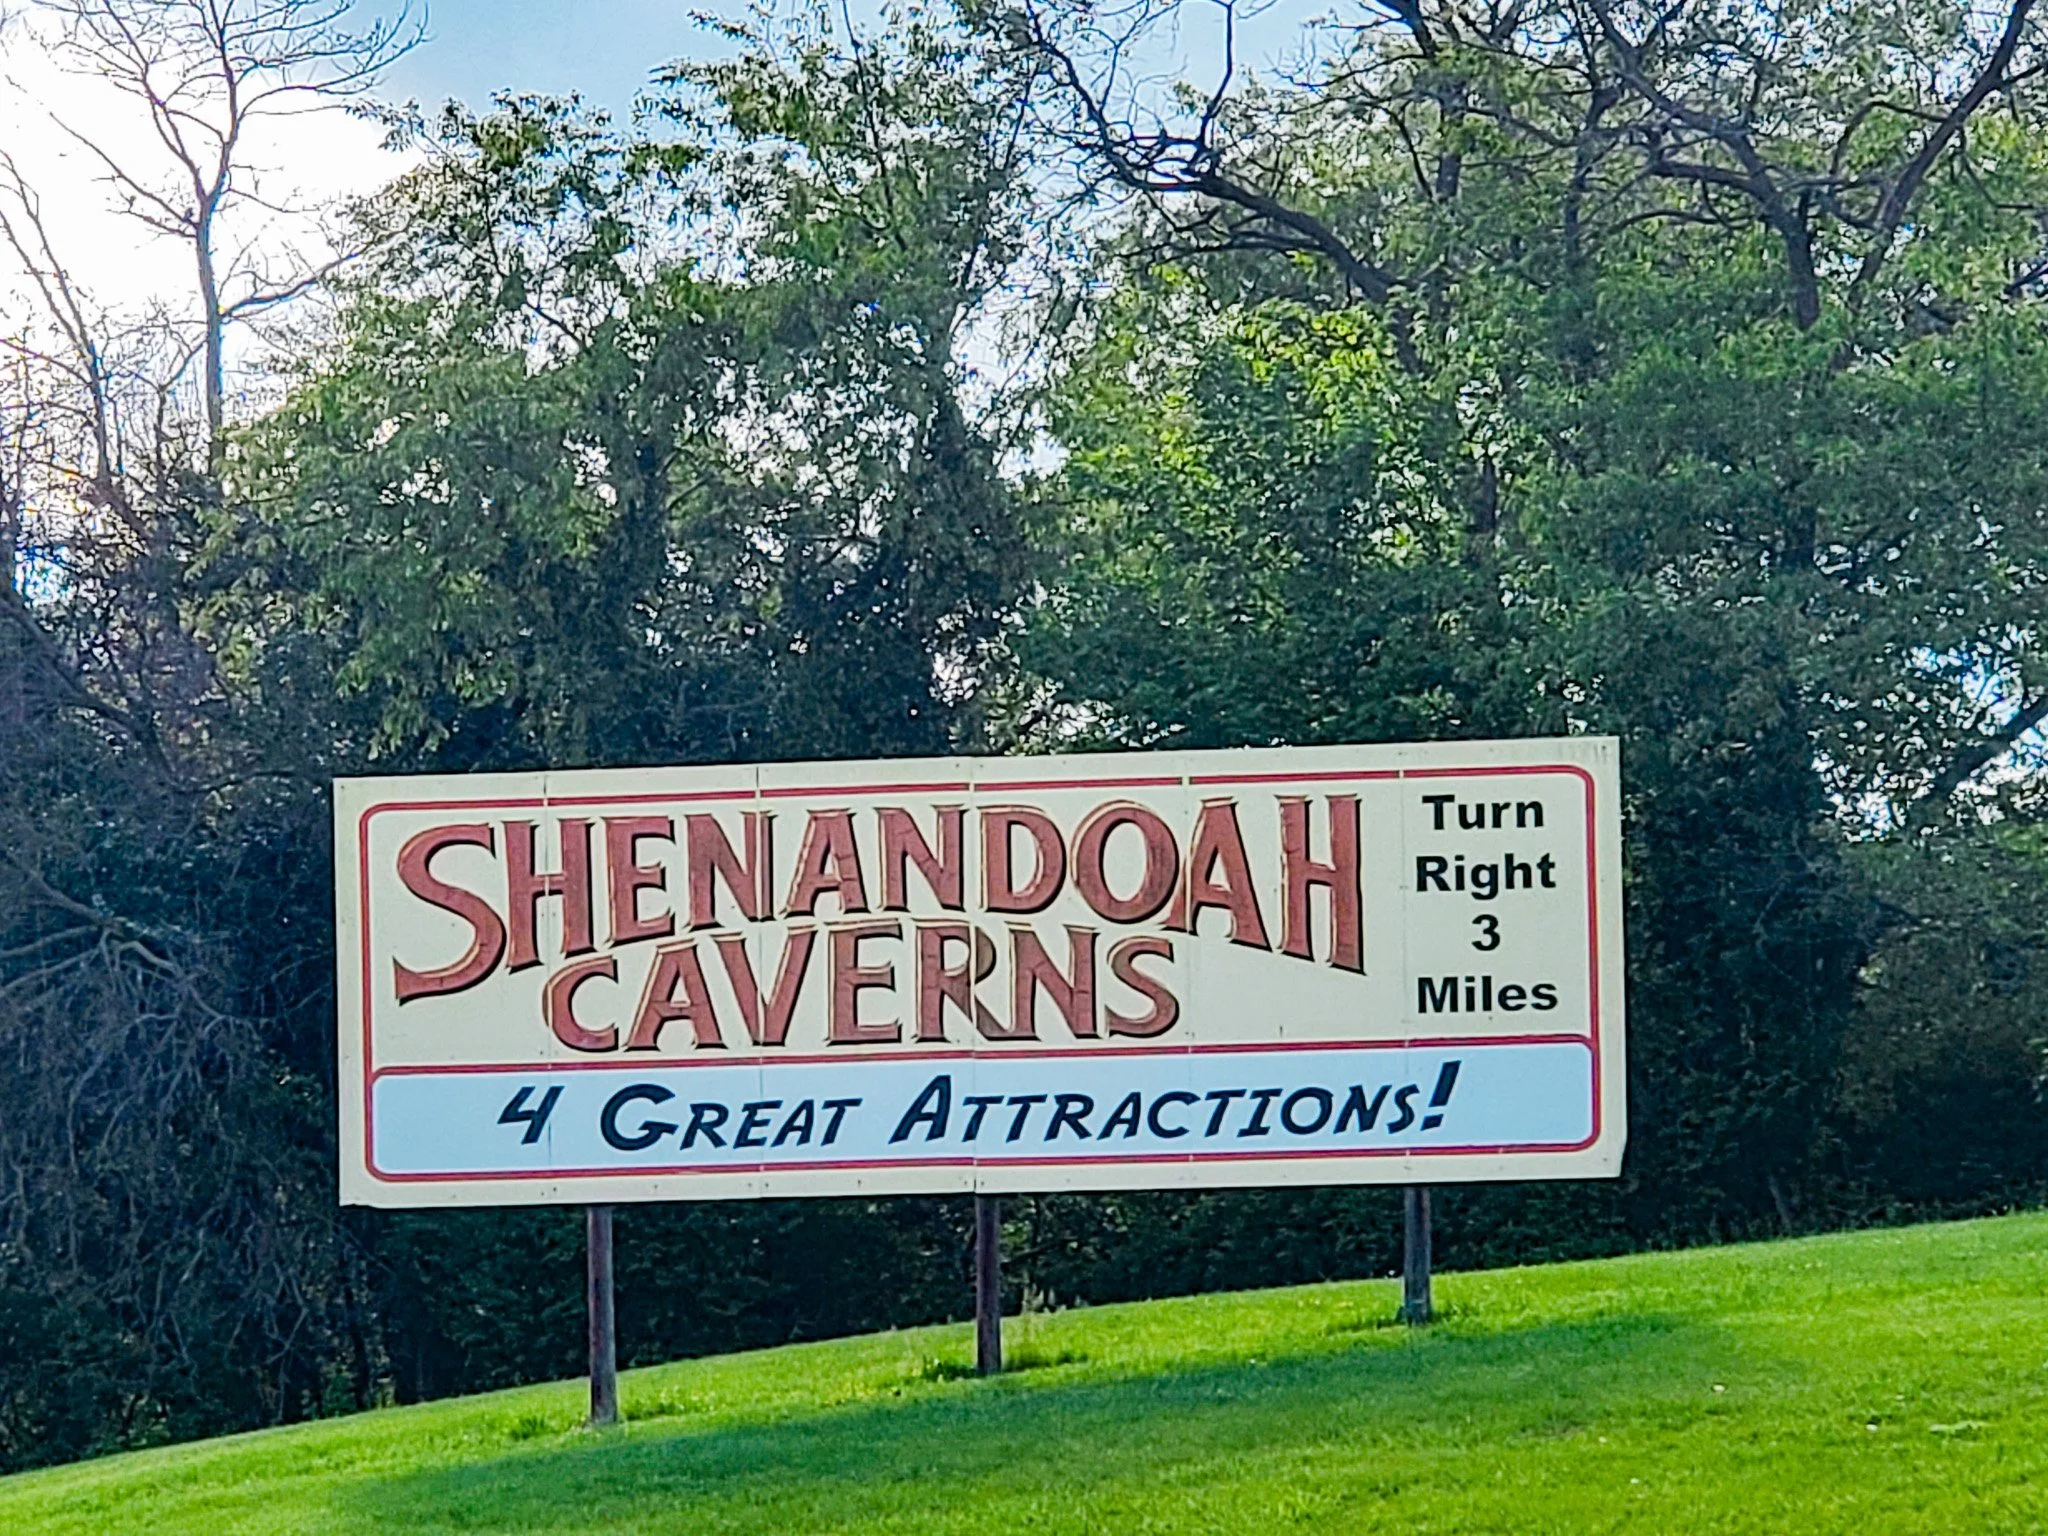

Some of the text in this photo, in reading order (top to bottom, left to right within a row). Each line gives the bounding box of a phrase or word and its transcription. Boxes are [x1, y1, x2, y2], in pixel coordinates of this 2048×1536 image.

[1422, 794, 1544, 830] Turn
[392, 794, 1366, 1006] SHENANDOAH
[1416, 853, 1556, 900] Right
[1471, 914, 1500, 951] 3
[542, 917, 1180, 1052] CAVERNS
[1418, 975, 1558, 1014] Miles
[497, 1060, 1462, 1151] 4 GREAT ATTRACTIONS!
